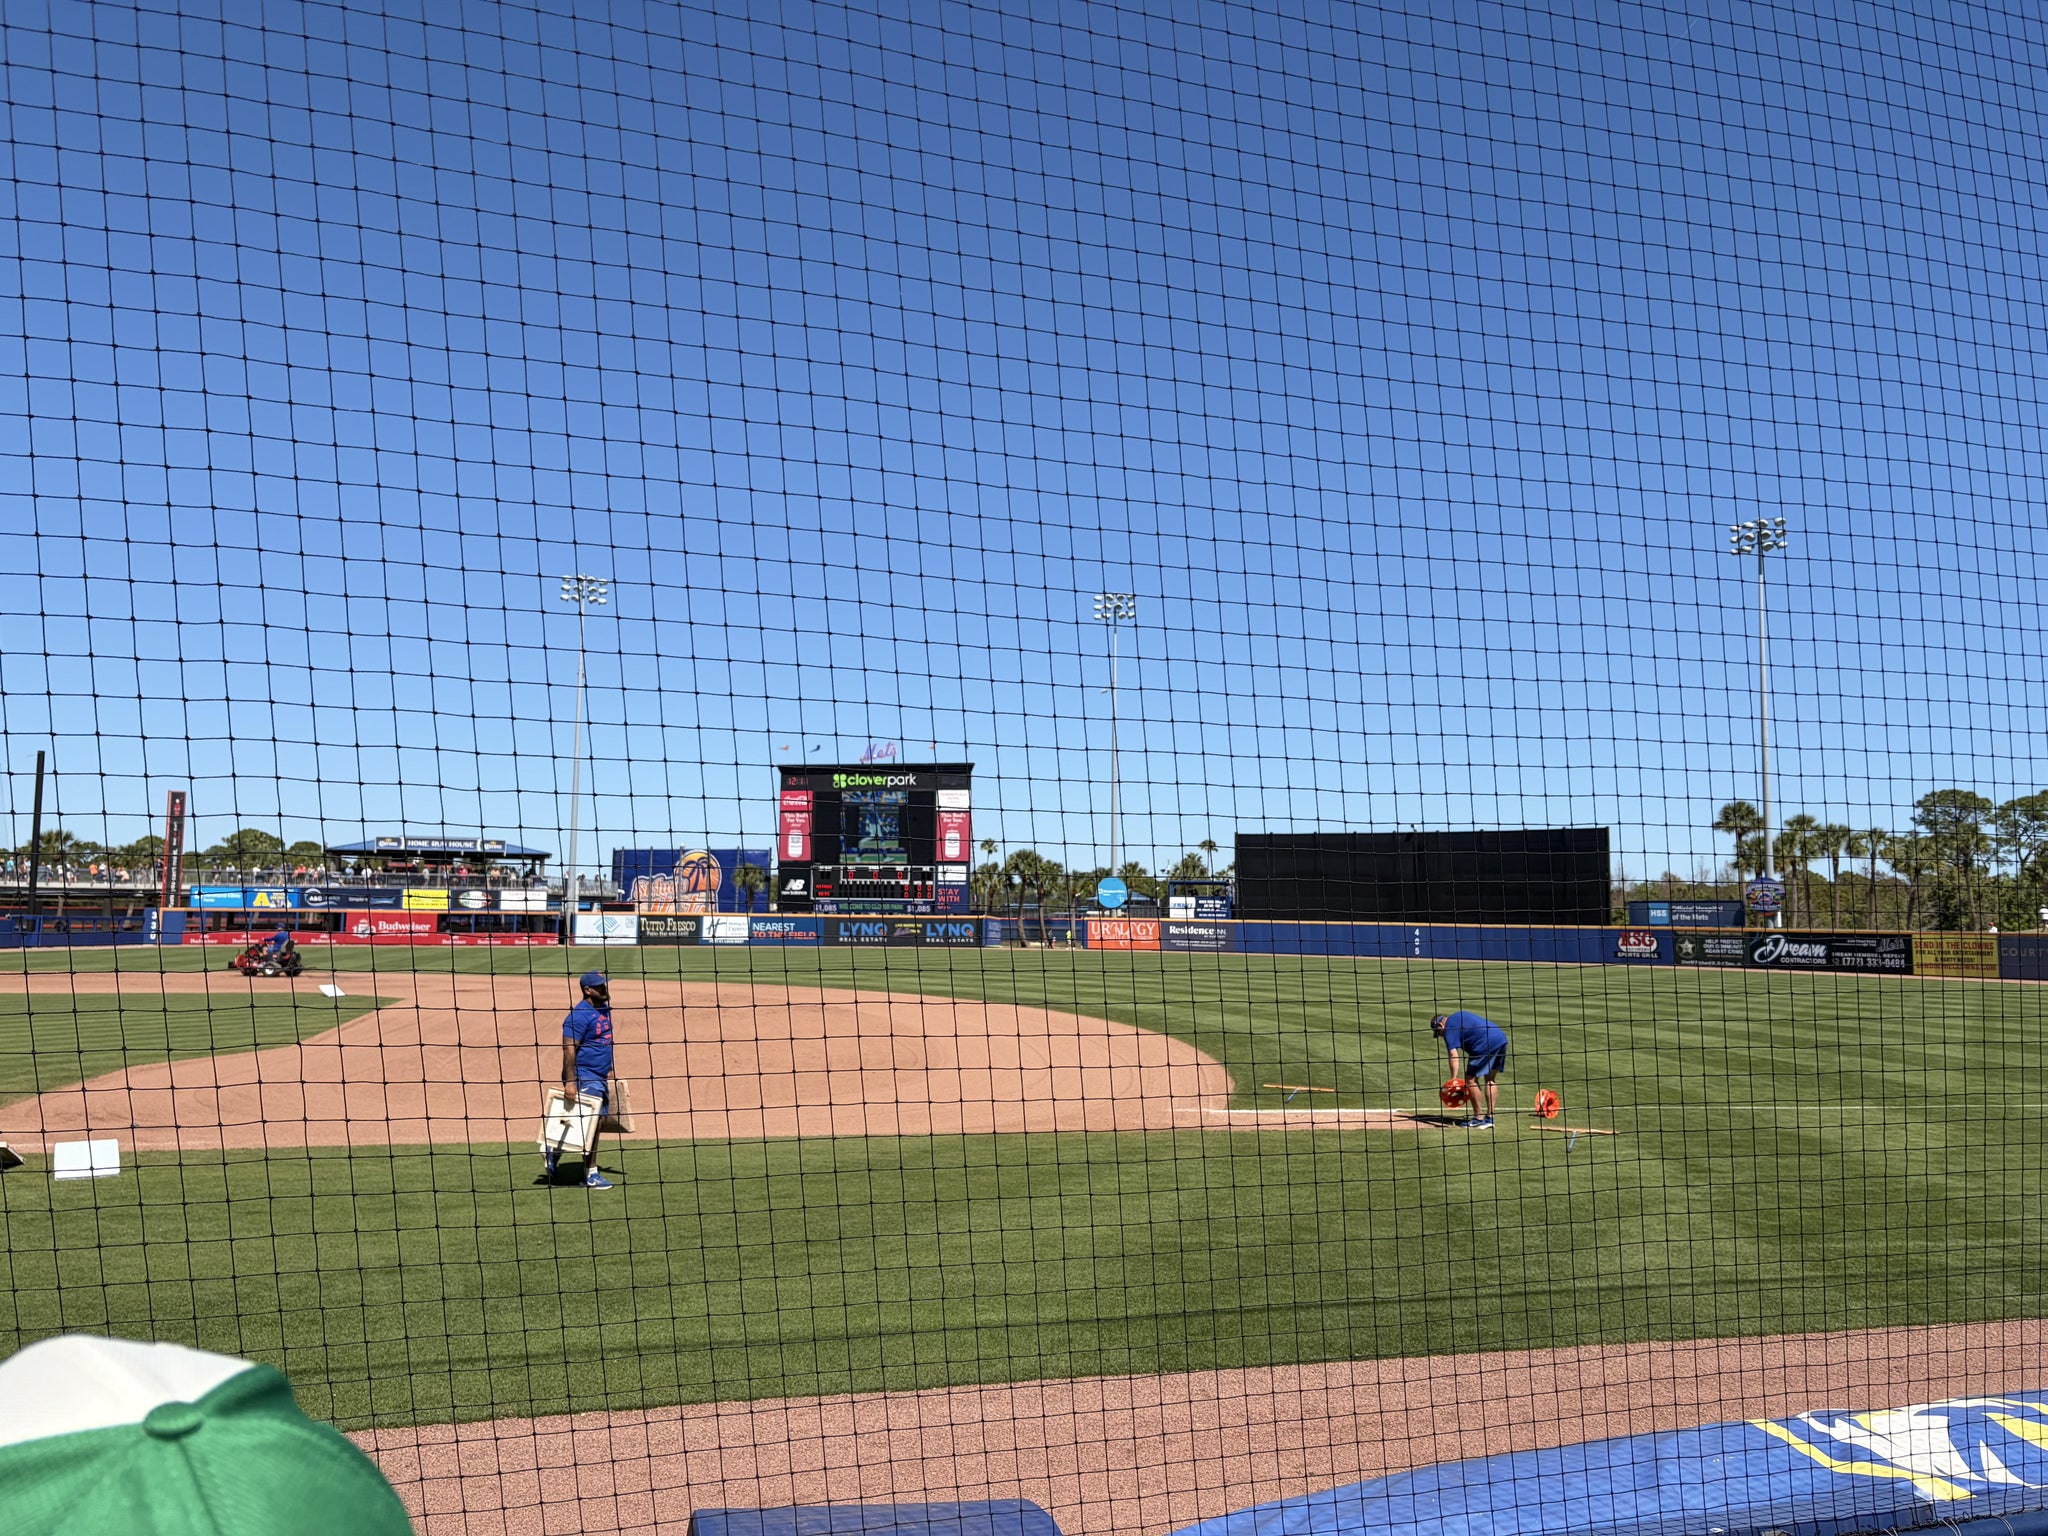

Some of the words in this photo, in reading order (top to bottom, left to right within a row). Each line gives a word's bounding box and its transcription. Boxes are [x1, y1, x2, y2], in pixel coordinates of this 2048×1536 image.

[860, 741, 897, 762] Mets
[407, 839, 430, 847] HOME
[431, 839, 448, 848] RUN
[449, 840, 474, 849] HOUSE
[1650, 909, 1667, 917] HSS
[378, 921, 431, 931] Budweiser
[752, 922, 796, 931] NEAREST
[1169, 925, 1215, 935] Residence
[753, 931, 767, 939] TO
[787, 931, 817, 939] FIELD
[1753, 934, 1827, 963] Dream
[1914, 941, 1934, 949] SEND
[1963, 942, 1994, 950] CLOWNS
